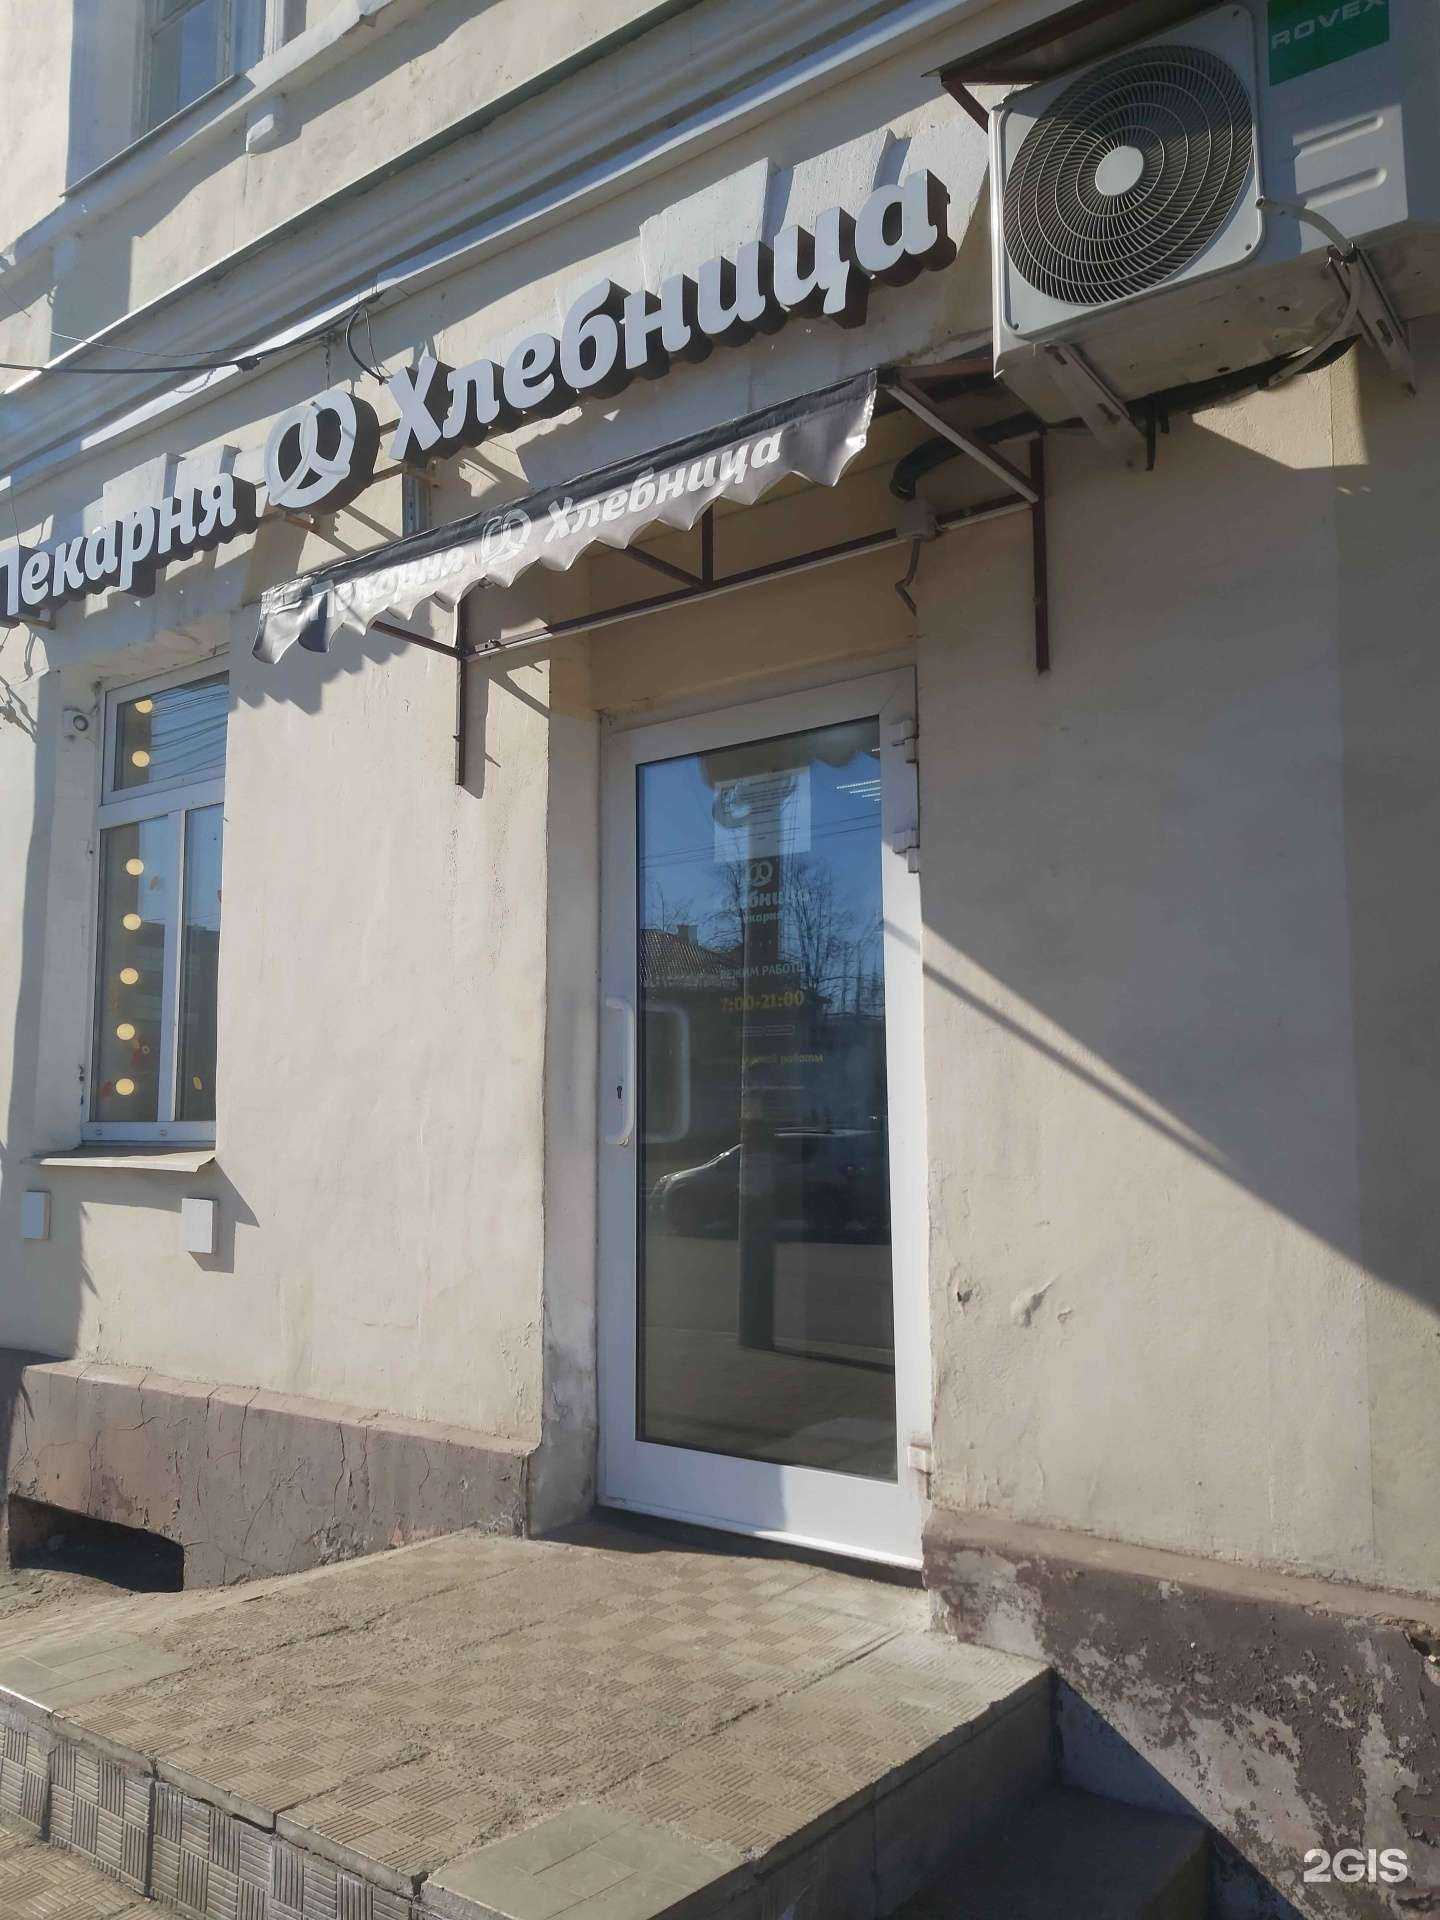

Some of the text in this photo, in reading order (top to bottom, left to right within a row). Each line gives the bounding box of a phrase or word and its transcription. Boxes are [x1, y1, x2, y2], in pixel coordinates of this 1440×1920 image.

[1271, 0, 1385, 49] ROVEX
[389, 169, 938, 459] Хлебница
[544, 431, 783, 543] Хлебница
